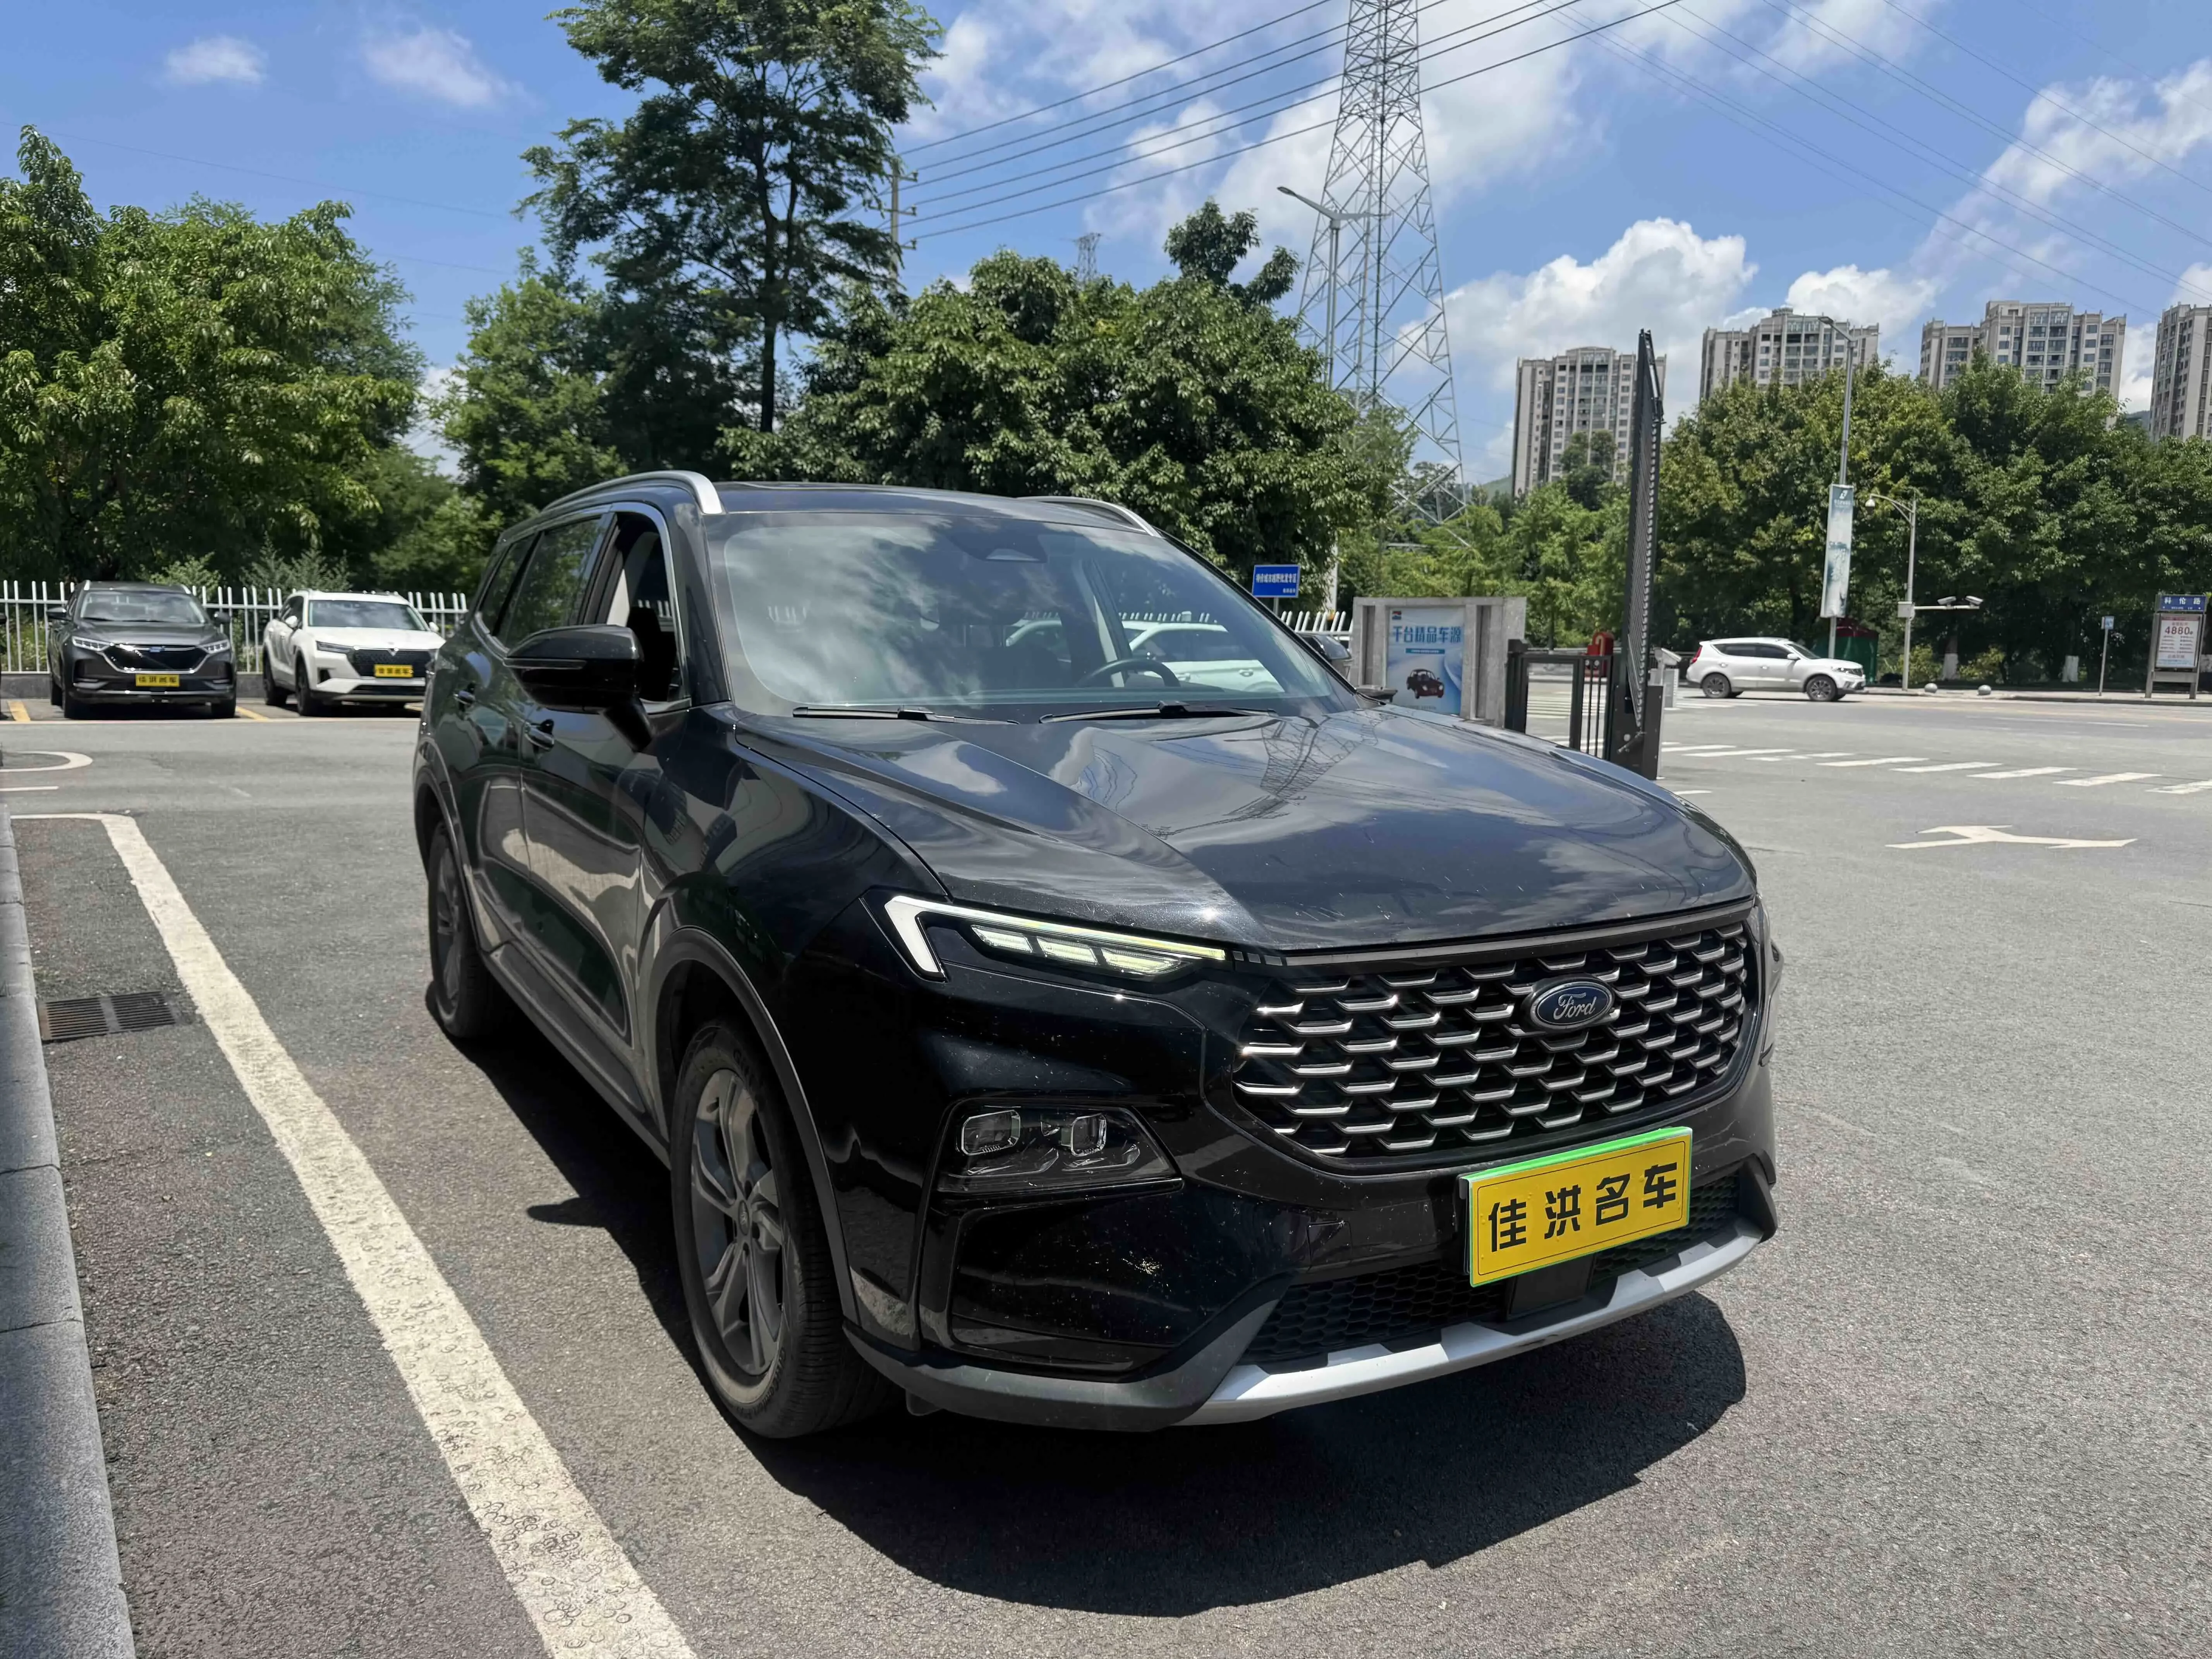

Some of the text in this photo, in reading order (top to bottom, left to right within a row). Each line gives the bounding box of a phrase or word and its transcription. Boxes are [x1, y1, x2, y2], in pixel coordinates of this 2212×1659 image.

[1553, 992, 1596, 1020] Ford
[1488, 1162, 1677, 1252] 佳洪名车
